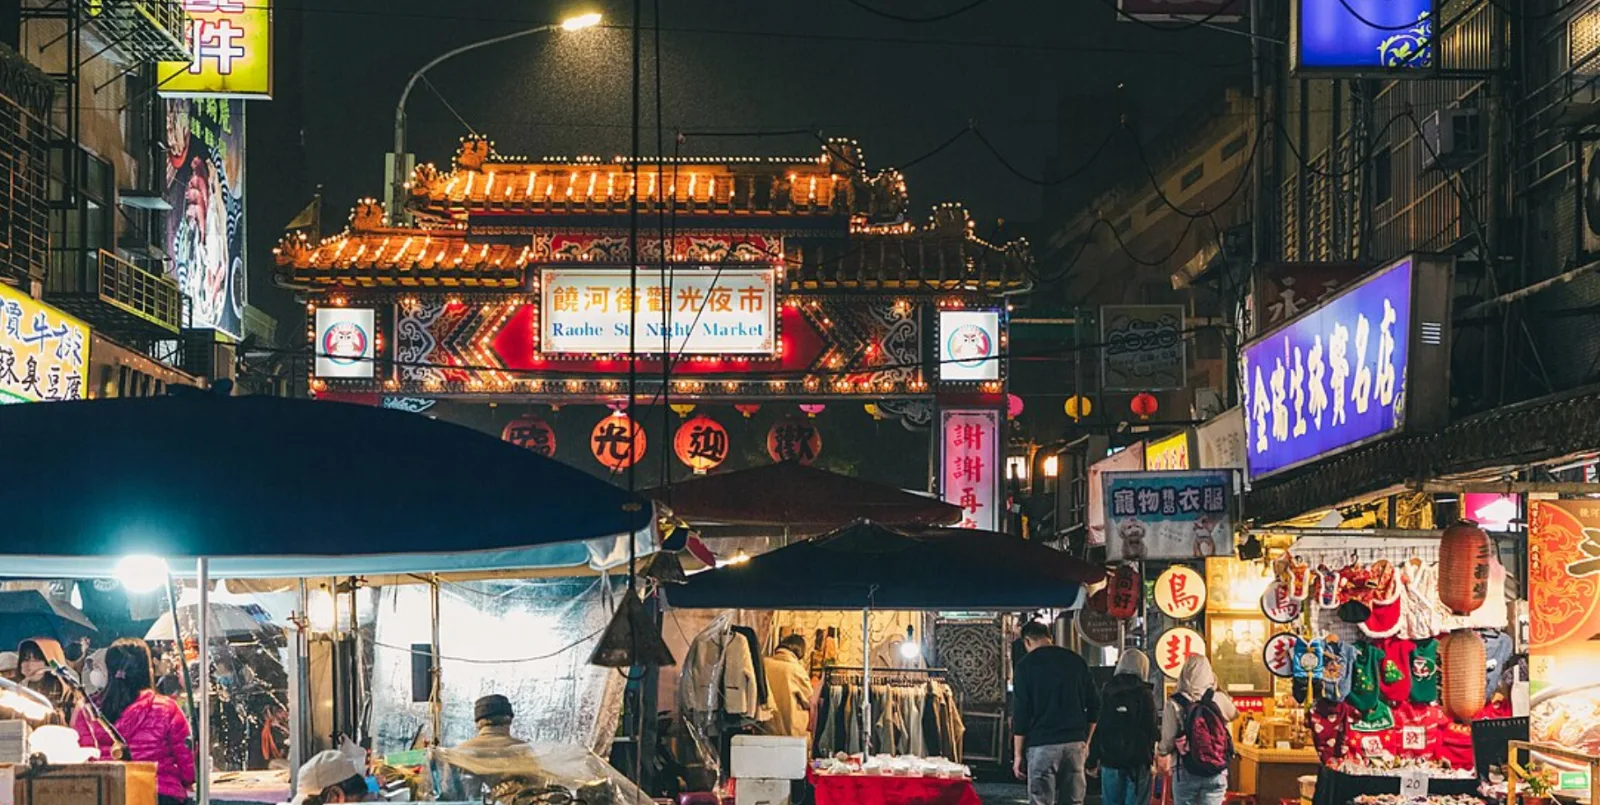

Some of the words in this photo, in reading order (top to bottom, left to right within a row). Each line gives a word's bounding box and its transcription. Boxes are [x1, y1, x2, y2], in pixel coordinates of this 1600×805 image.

[553, 285, 765, 313] 饒河街觀光夜市
[552, 322, 603, 337] Raohe
[646, 322, 691, 340] Night
[703, 322, 763, 337] Market
[595, 423, 634, 460] 光
[690, 426, 725, 461] 迎
[1168, 573, 1199, 612] 鳥
[1164, 634, 1198, 670] 卦
[1406, 779, 1420, 790] 20
